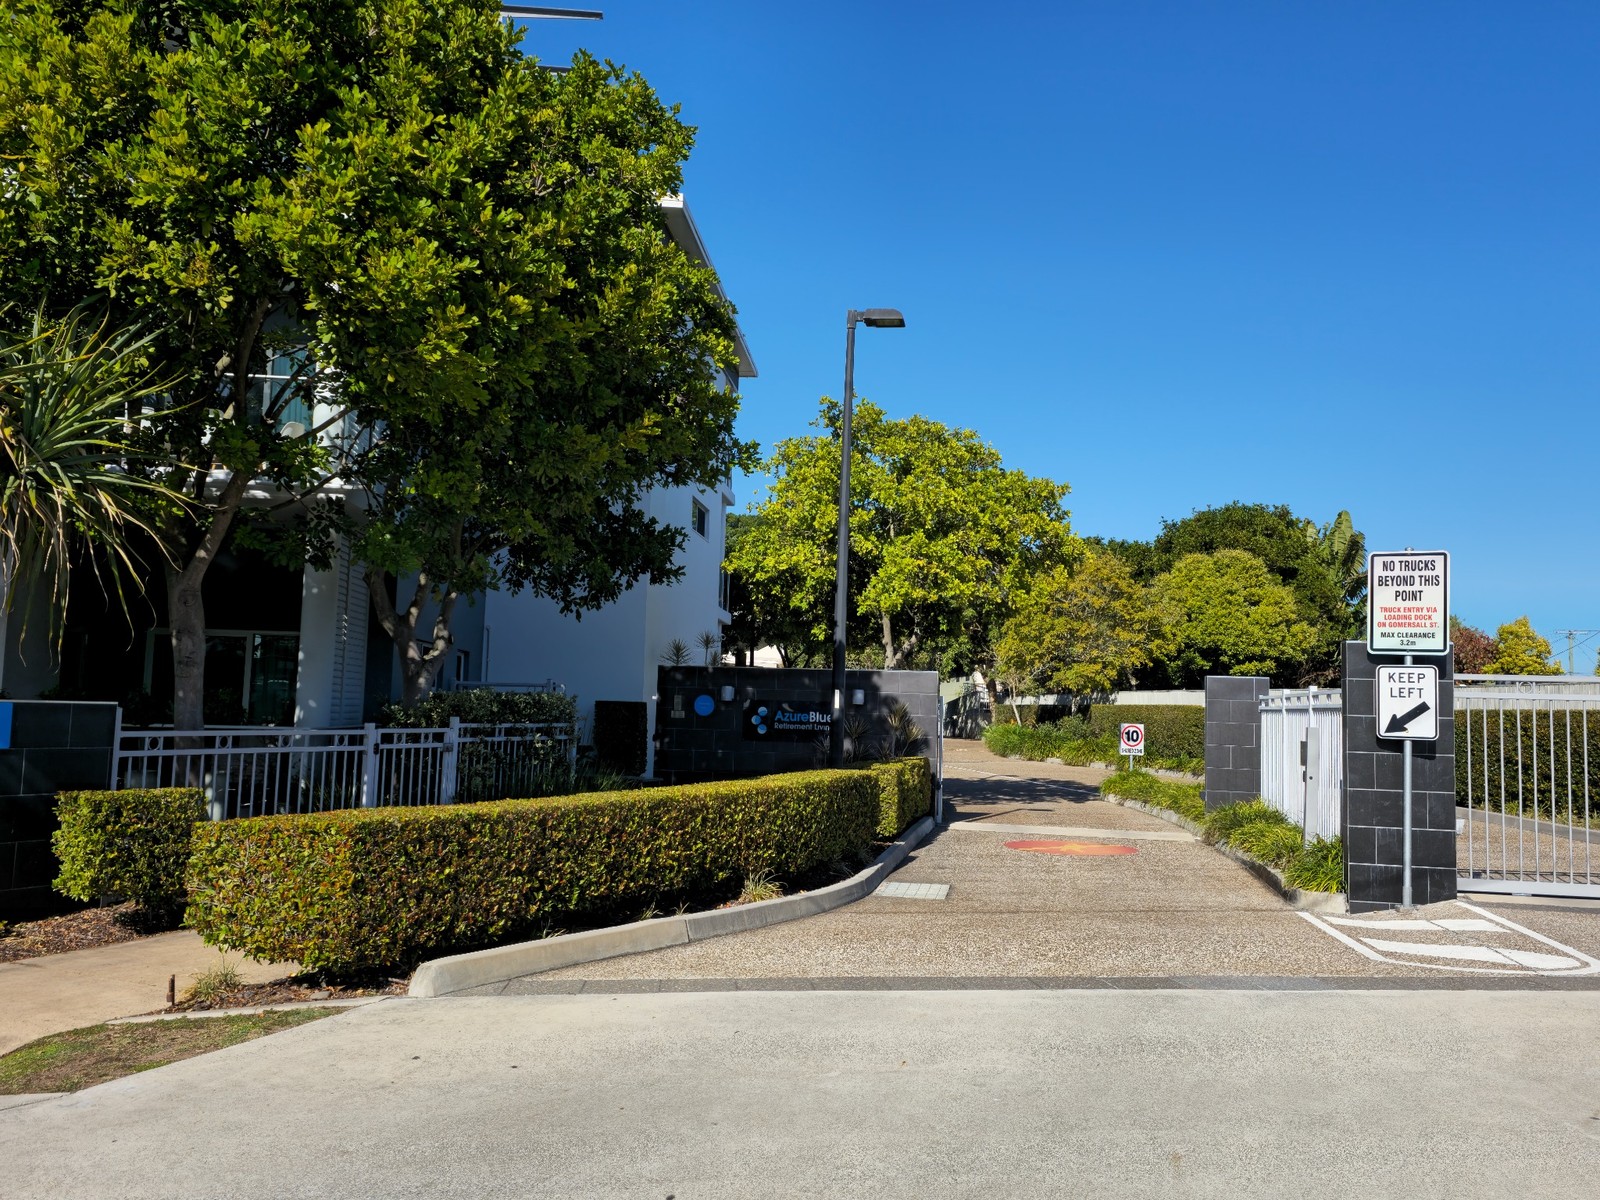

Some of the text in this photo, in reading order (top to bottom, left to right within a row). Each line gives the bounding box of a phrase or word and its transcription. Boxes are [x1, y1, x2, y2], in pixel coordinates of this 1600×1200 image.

[1382, 559, 1436, 572] NO TRUCKS
[1377, 574, 1440, 587] BEYOND THIS
[1394, 590, 1424, 602] POINT
[1388, 672, 1426, 684] KEEP
[1390, 687, 1424, 699] LEFT
[774, 710, 831, 723] AzureBlue
[774, 722, 830, 731] Retirement Livin
[1125, 730, 1139, 742] 10
